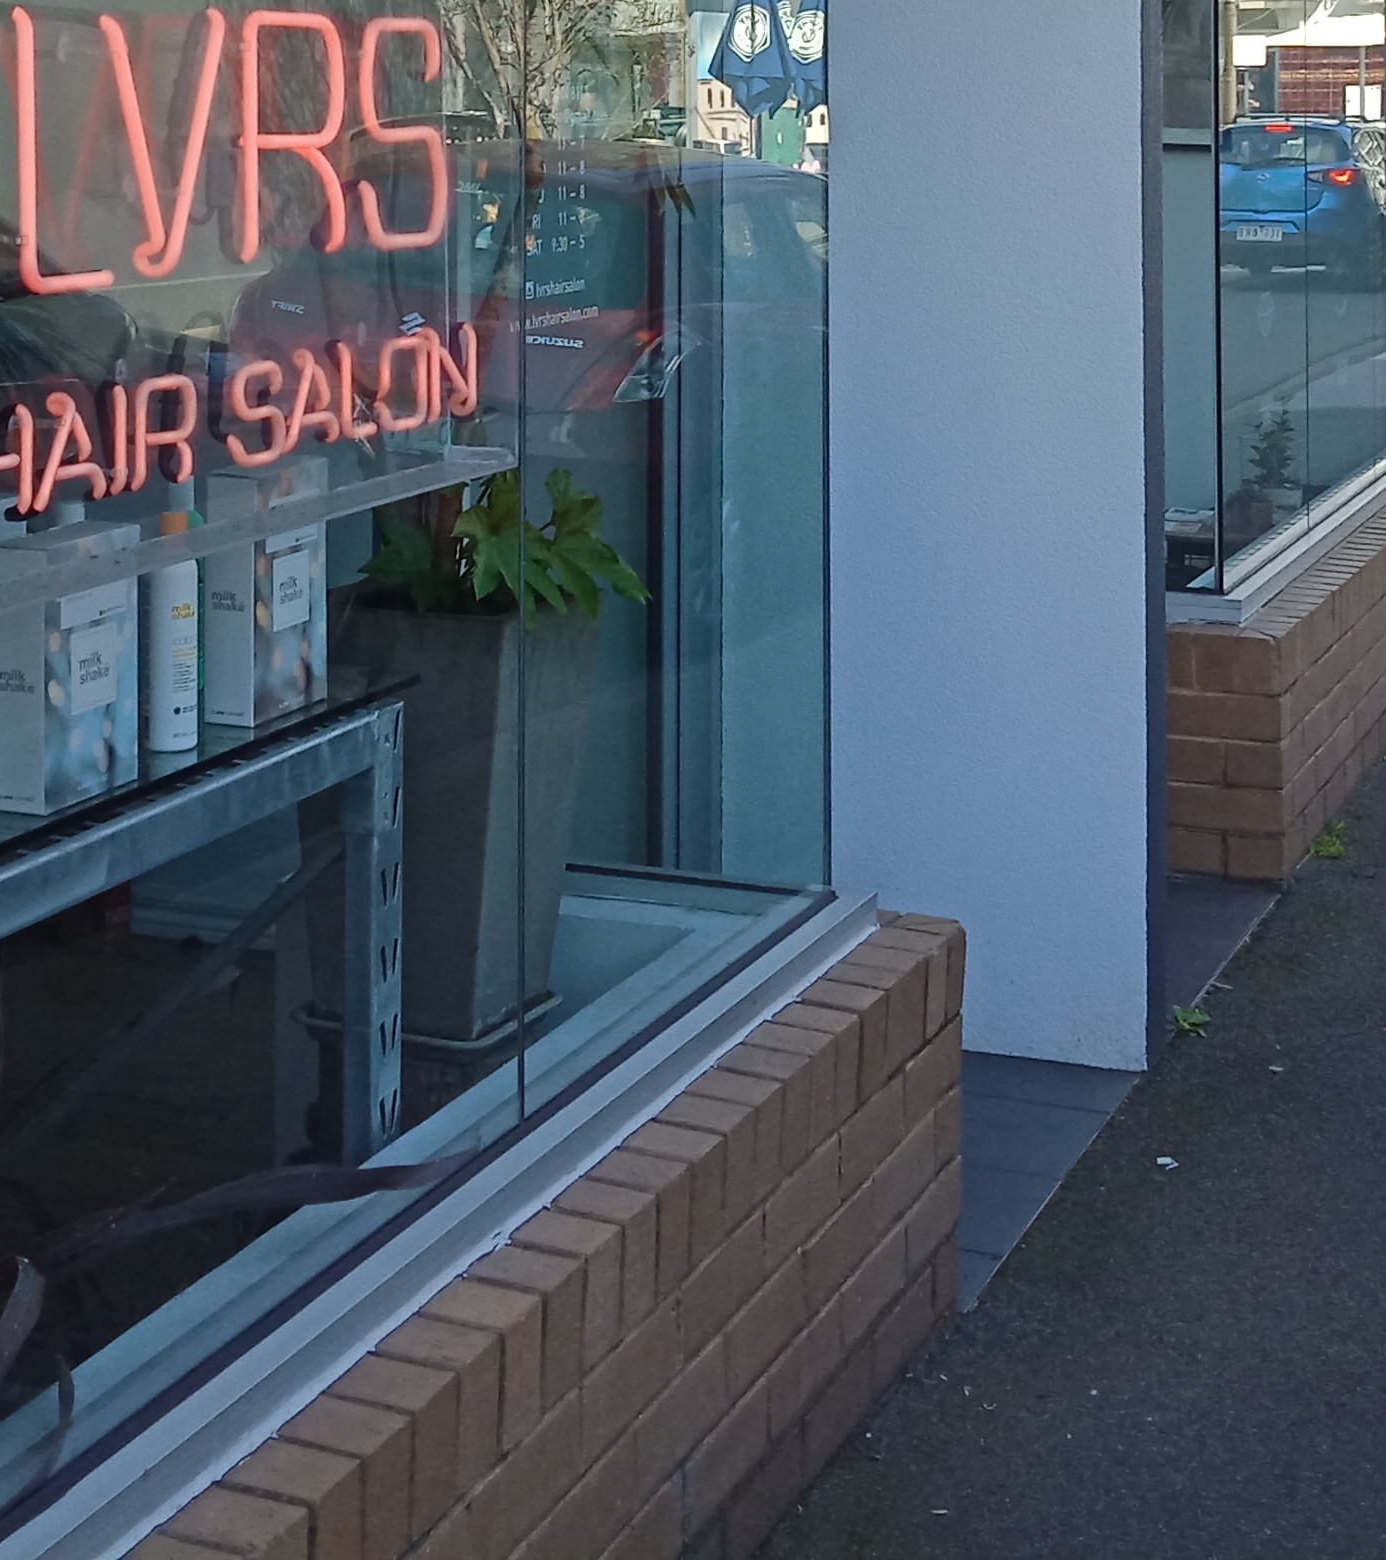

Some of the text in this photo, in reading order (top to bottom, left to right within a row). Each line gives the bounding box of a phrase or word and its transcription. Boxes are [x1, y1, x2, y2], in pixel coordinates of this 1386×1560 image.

[12, 6, 448, 294] LVRS
[226, 323, 477, 467] SALON
[79, 650, 102, 671] milk
[79, 665, 110, 685] shake
